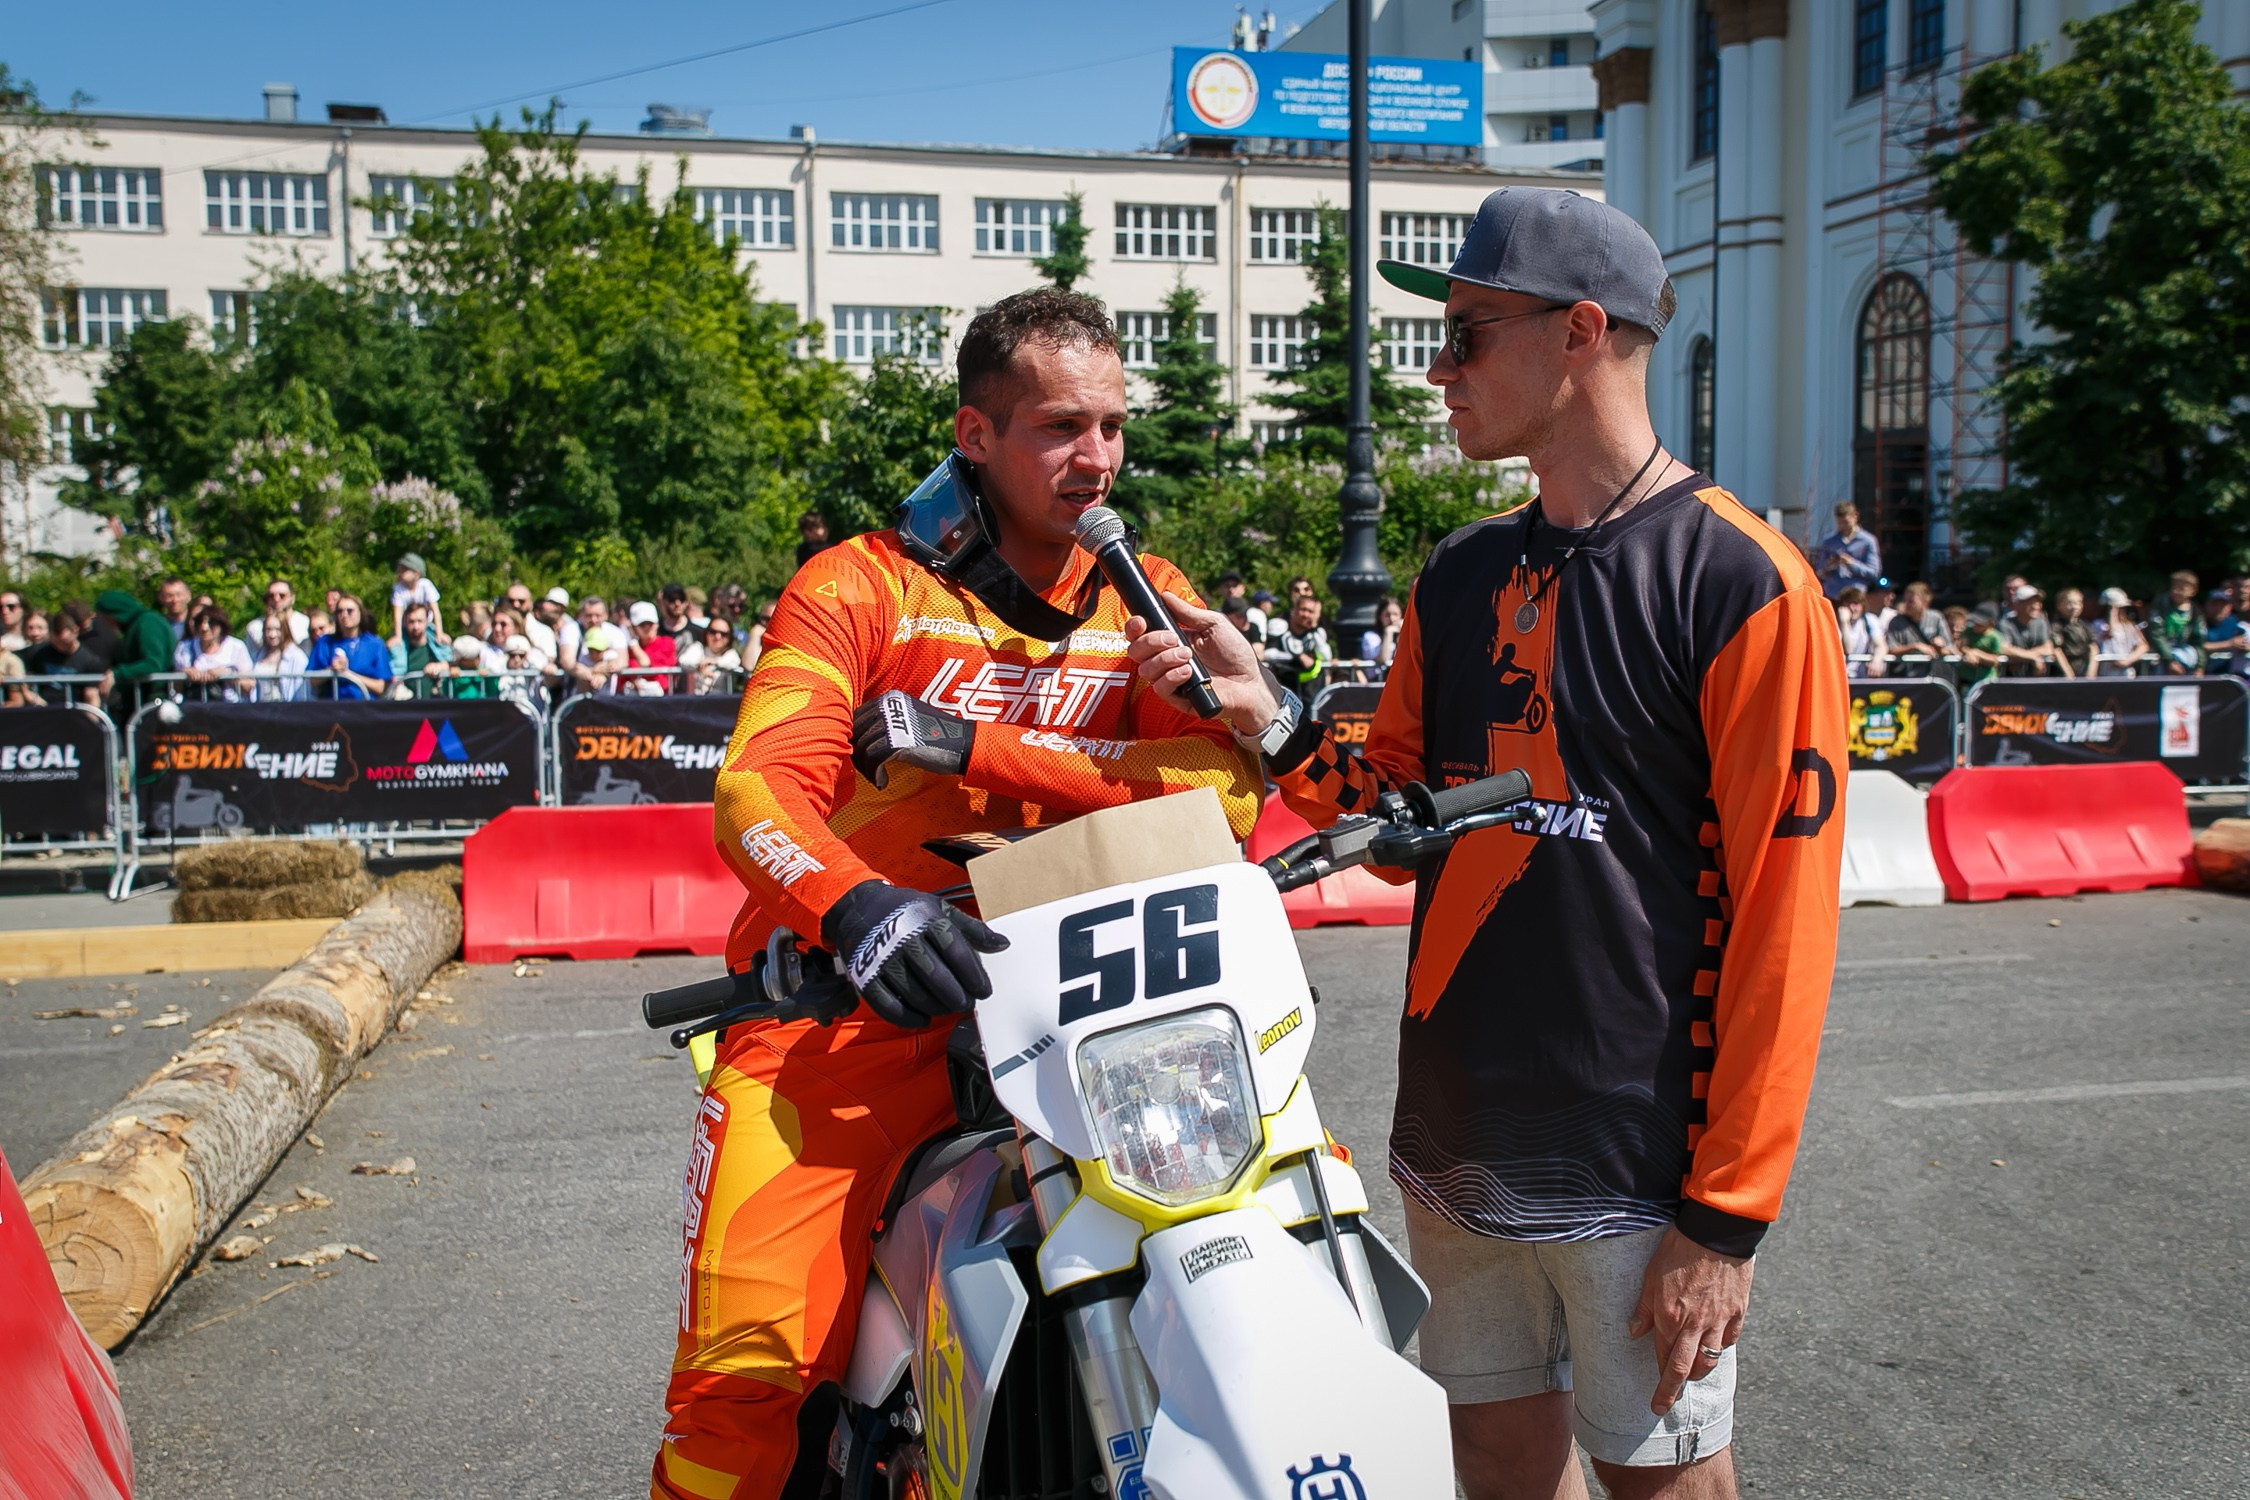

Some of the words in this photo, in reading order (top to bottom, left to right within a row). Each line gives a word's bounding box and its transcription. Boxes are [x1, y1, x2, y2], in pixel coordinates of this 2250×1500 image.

[920, 657, 1130, 727] LEATT
[0, 743, 80, 771] EGAL
[1058, 884, 1221, 1027] 56
[1254, 1007, 1303, 1055] Leonov
[703, 1249, 714, 1310] MOTO
